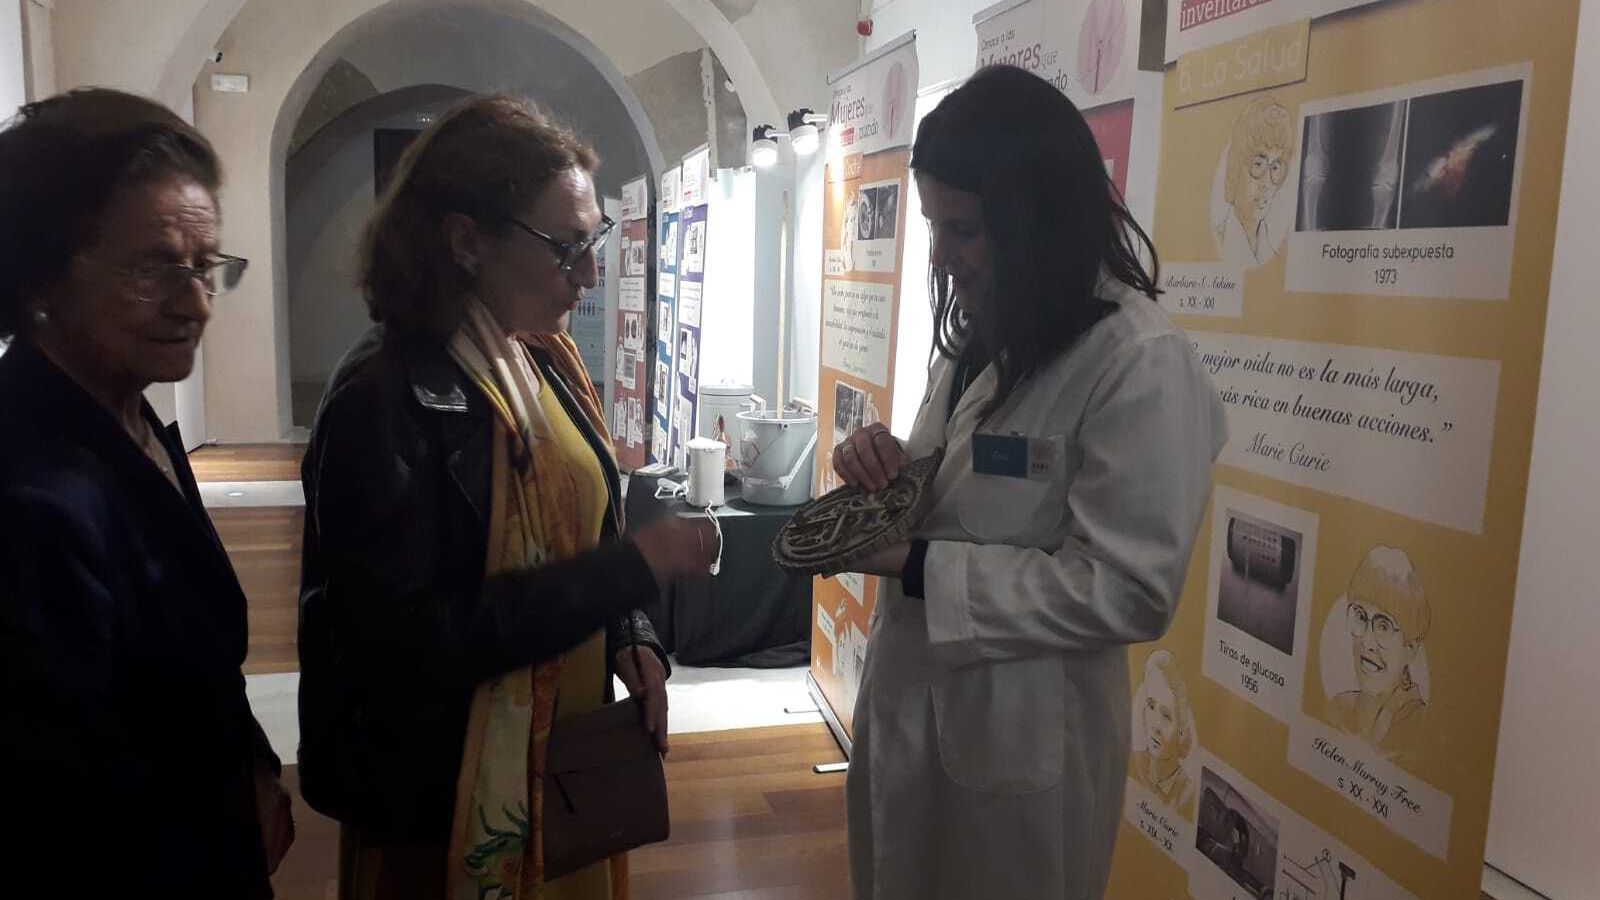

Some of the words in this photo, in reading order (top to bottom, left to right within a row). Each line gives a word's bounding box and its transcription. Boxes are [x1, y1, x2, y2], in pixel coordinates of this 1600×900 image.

[1182, 0, 1266, 28] inventar
[1203, 58, 1228, 88] La
[1234, 34, 1303, 80] Salud
[831, 97, 865, 126] Mujeres
[1382, 243, 1454, 263] subexpuesta
[1375, 268, 1397, 284] 1973
[1201, 350, 1240, 375] mejor
[1243, 352, 1273, 374] vida
[1277, 363, 1294, 379] no
[1298, 366, 1316, 380] es
[1320, 359, 1338, 384] la
[1343, 367, 1381, 390] más
[1384, 366, 1439, 405] larga,
[1220, 386, 1239, 405] ás
[1242, 389, 1270, 411] rica
[1273, 400, 1290, 415] en
[1292, 394, 1353, 426] buenas
[1245, 431, 1284, 461] Marie
[1289, 441, 1332, 473] Curie
[1219, 640, 1239, 661] Tiras
[1240, 651, 1251, 668] de
[1252, 661, 1285, 687] glucosa
[1241, 673, 1259, 694] 1956
[1312, 738, 1345, 766] Helen
[1346, 760, 1389, 796] Murray
[1391, 785, 1421, 814] Free
